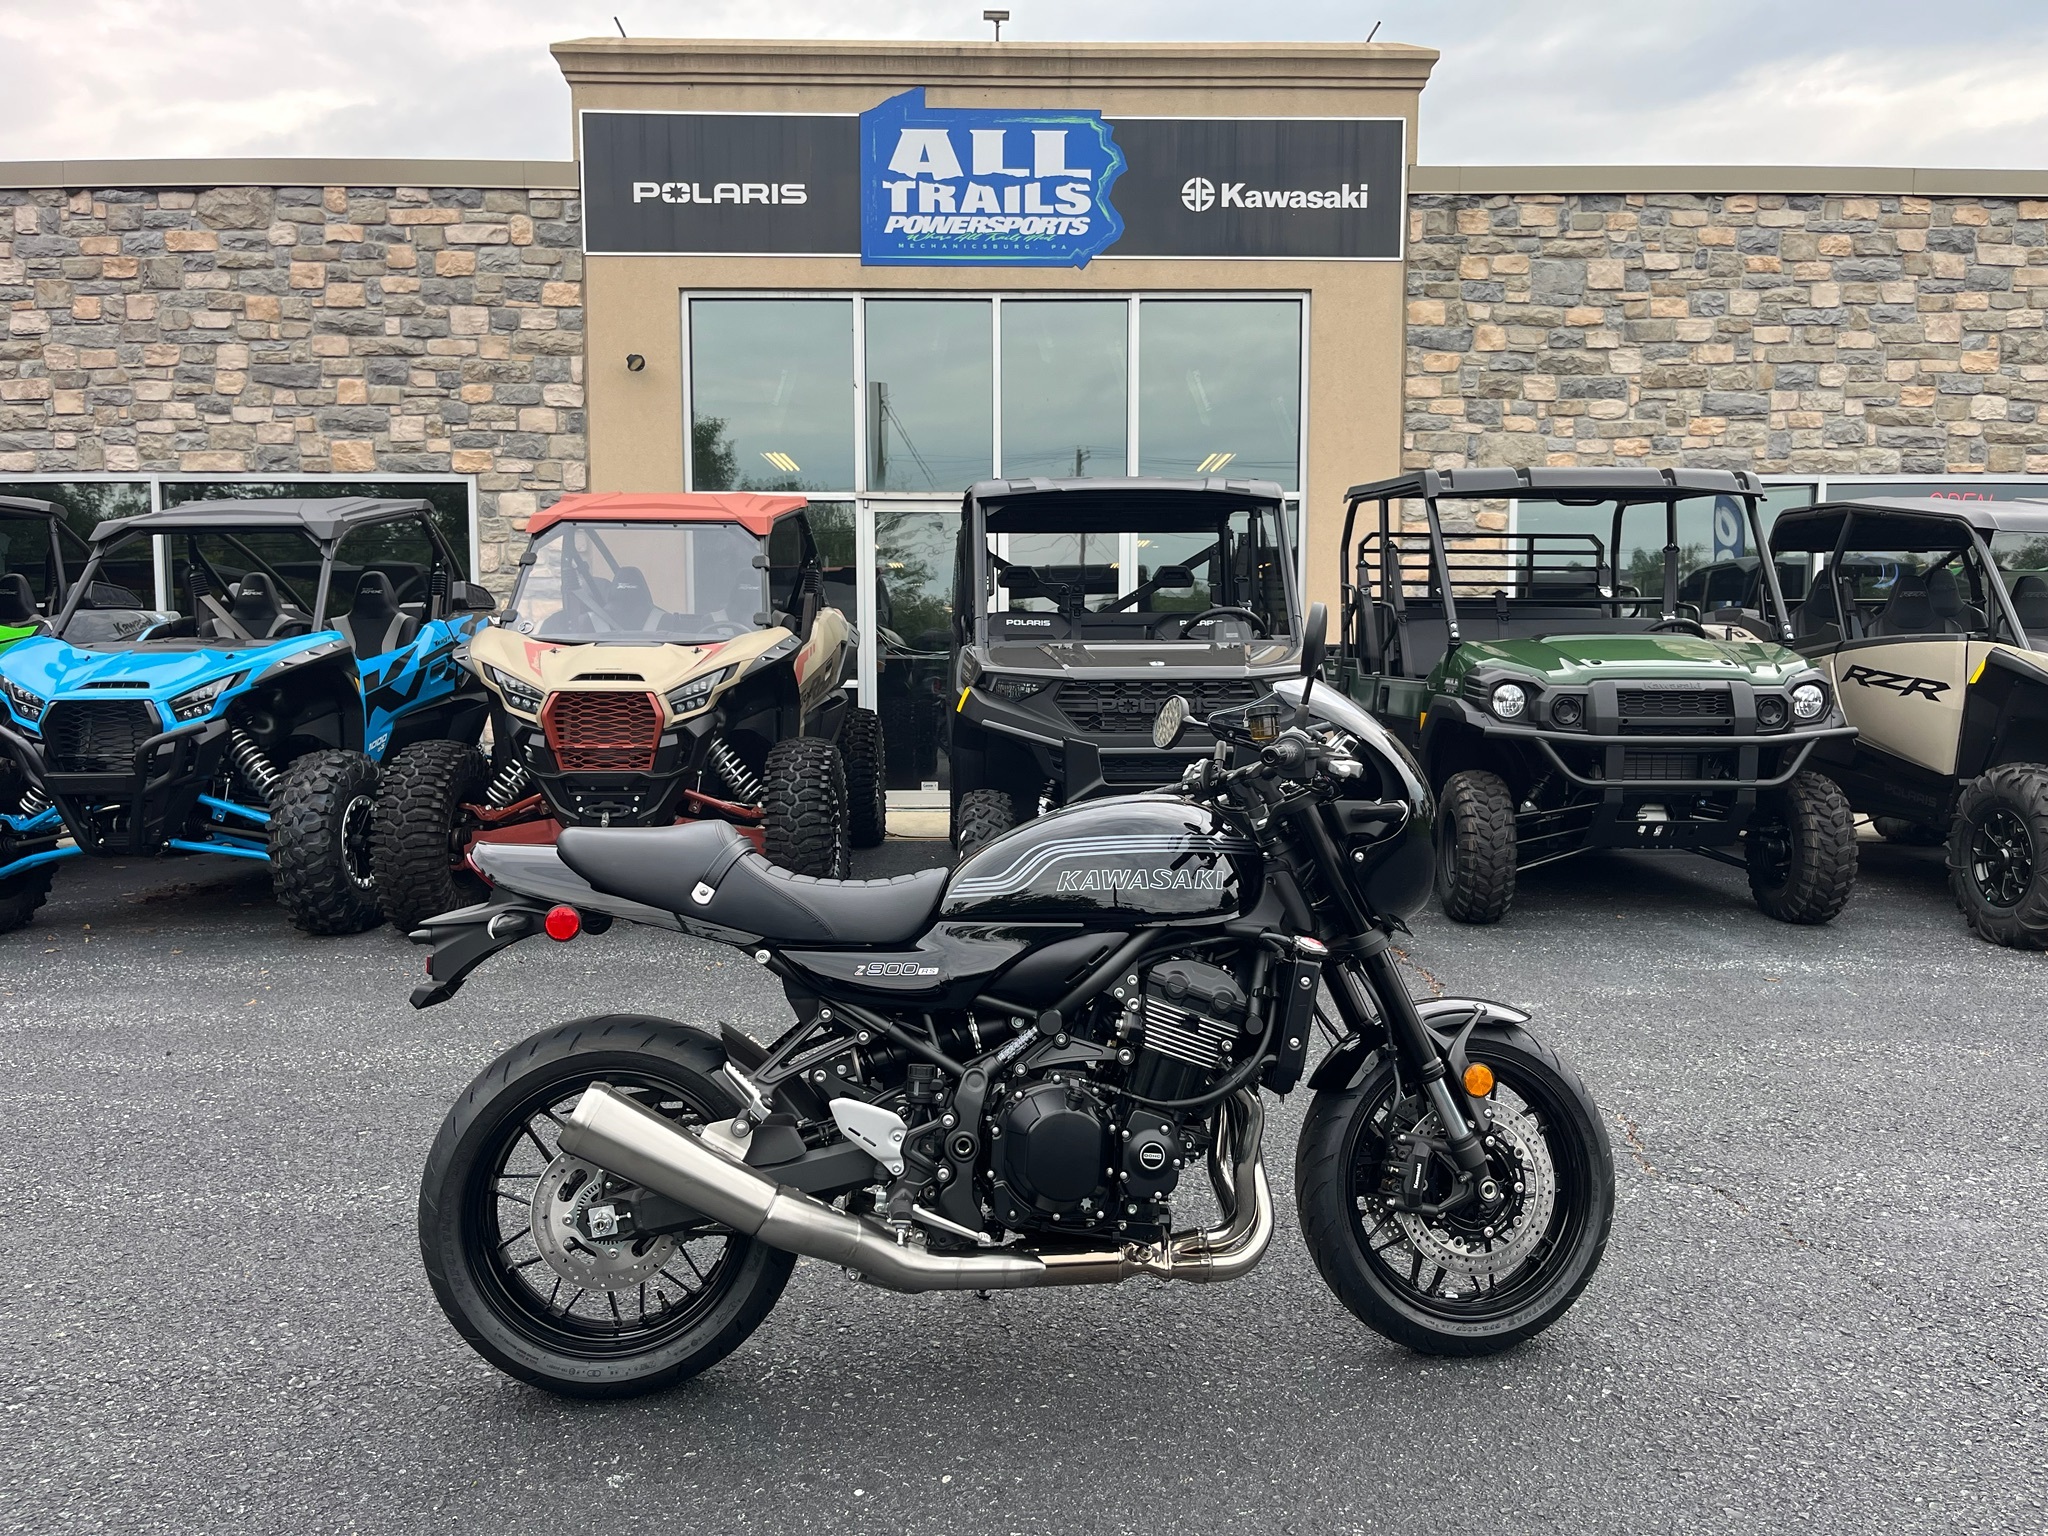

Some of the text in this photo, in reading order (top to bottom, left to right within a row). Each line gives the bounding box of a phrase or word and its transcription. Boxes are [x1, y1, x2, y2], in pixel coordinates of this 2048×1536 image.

[888, 129, 1092, 181] ALL
[633, 182, 808, 204] POLARIS
[882, 181, 1092, 215] TRAILS
[1221, 182, 1368, 209] Kawasaki
[884, 215, 1091, 236] POWERSPORTS
[1006, 619, 1051, 627] POLARIS
[1841, 664, 1951, 702] RZR
[1098, 698, 1221, 713] POLIS
[1056, 868, 1224, 892] KAWASAKI
